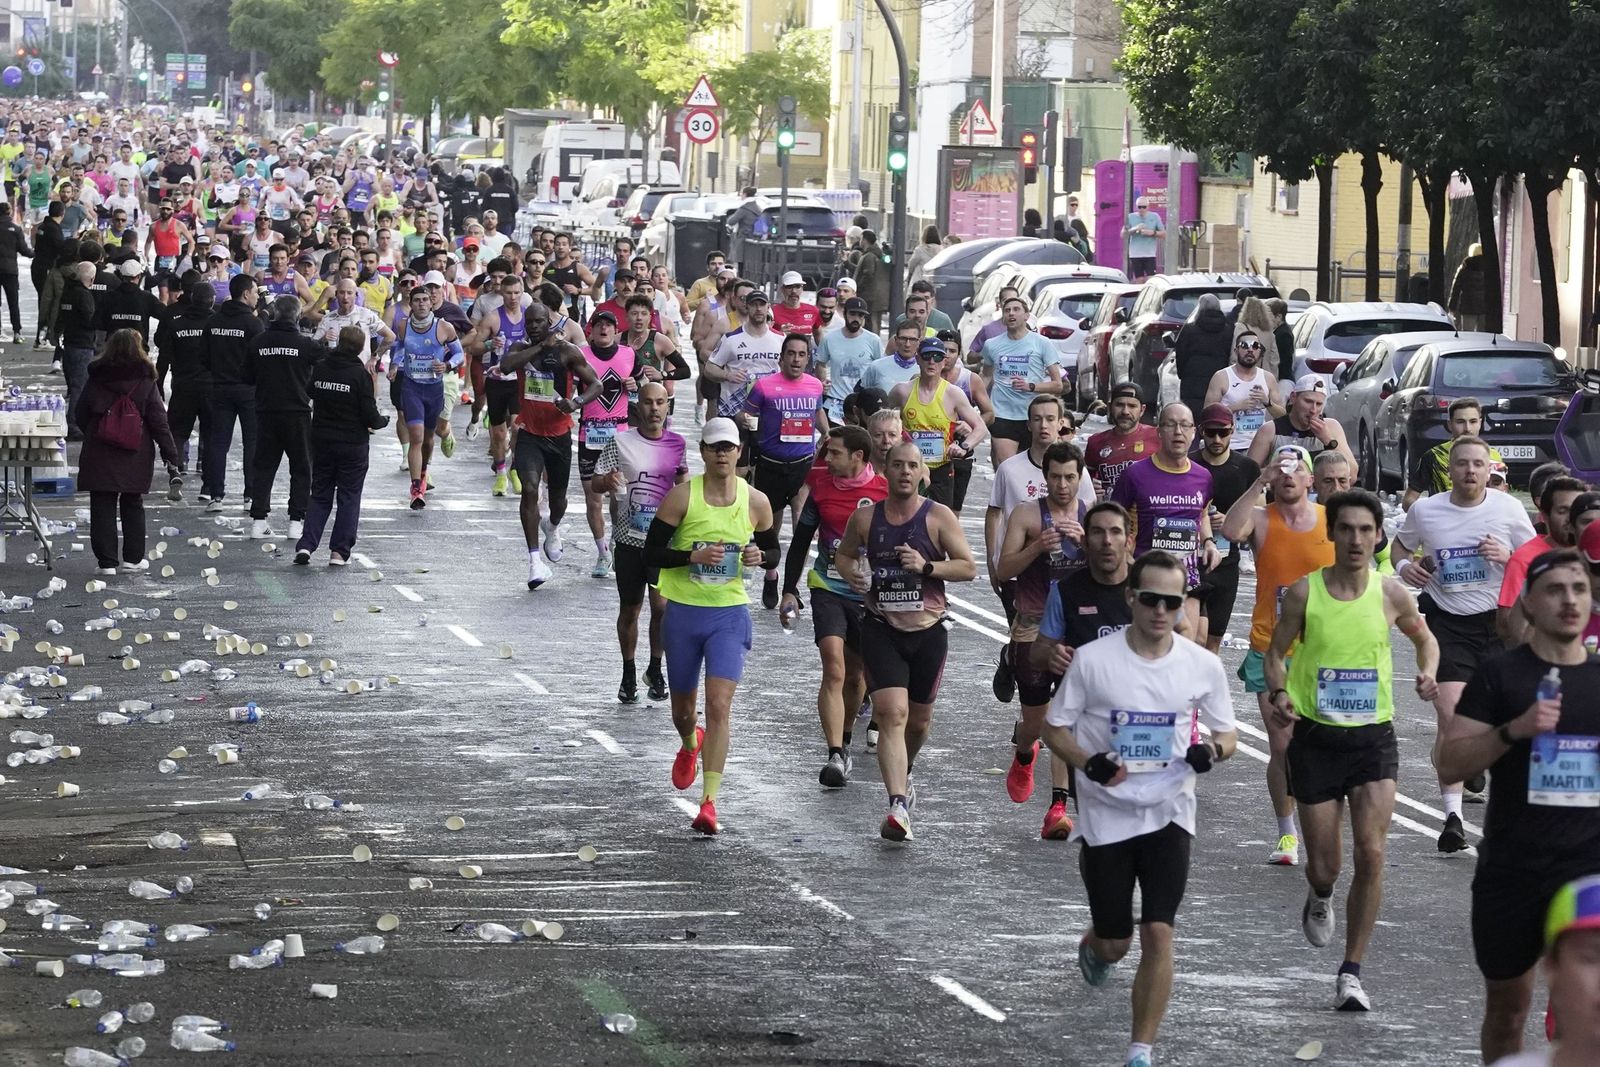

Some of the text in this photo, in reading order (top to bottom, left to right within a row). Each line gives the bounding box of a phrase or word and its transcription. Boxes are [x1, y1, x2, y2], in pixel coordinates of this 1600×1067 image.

[691, 120, 711, 132] 30
[112, 313, 142, 321] VOLUNTEER
[210, 327, 245, 338] VOLUNTEER
[259, 347, 299, 357] VOLUNTEER
[1513, 447, 1533, 457] GBR
[1149, 495, 1197, 505] WellChild
[1152, 539, 1196, 550] MORRISON
[701, 565, 727, 575] MASE
[1443, 570, 1486, 582] KRISTIAN
[878, 590, 920, 601] ROBERTO
[1339, 672, 1373, 680] ZURICH
[1319, 699, 1376, 711] CHAUVEAU
[1133, 714, 1169, 724] ZURICH
[1558, 740, 1599, 750] ZURICH
[1120, 745, 1161, 758] PLEINS
[1542, 774, 1595, 788] MARTIN
